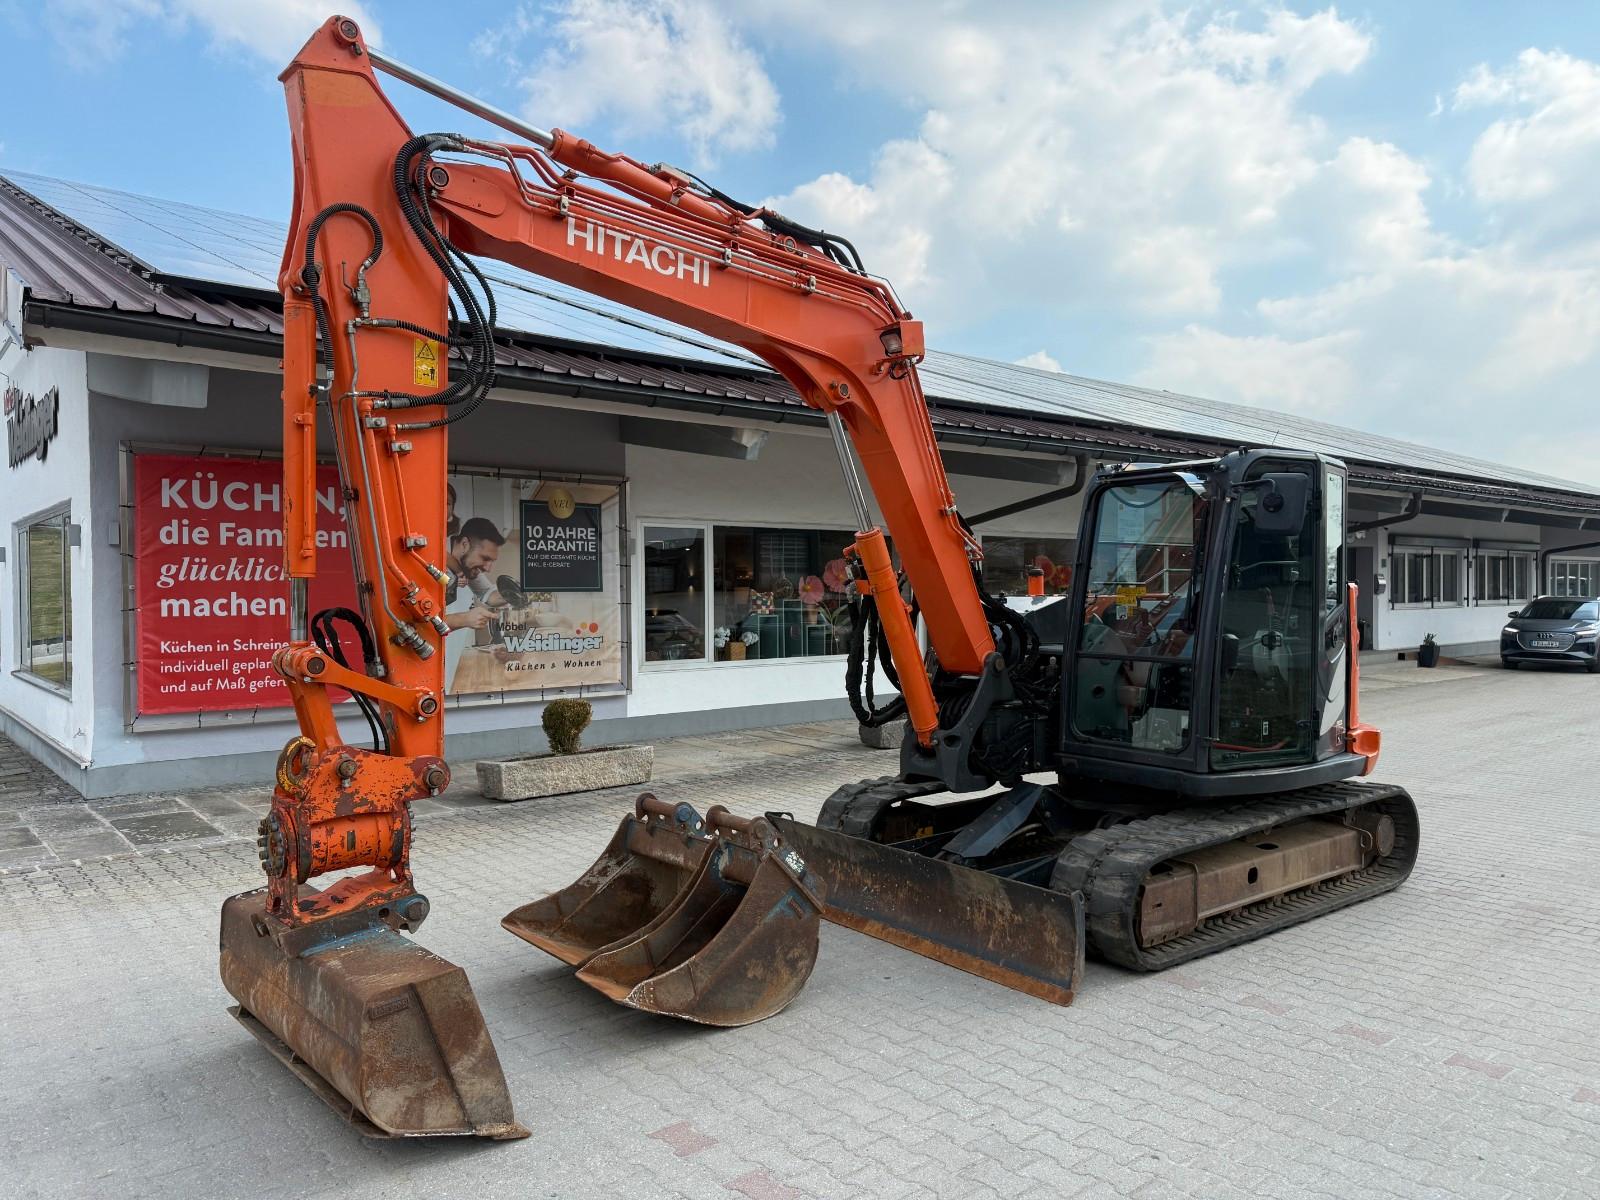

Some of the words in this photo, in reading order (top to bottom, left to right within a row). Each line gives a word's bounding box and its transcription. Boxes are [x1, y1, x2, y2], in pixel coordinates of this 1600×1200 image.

[567, 217, 710, 287] HITACHI
[161, 471, 347, 522] KÜCHN,
[159, 519, 210, 545] die
[219, 522, 347, 549] Famen
[526, 525, 543, 539] 10
[547, 526, 596, 540] JAHRE
[526, 540, 597, 552] GARANTIE
[160, 591, 287, 617] machen
[496, 622, 527, 632] Möbel
[160, 640, 213, 654] Küchen
[217, 640, 229, 652] in
[503, 627, 604, 654] Weidinger
[160, 658, 228, 673] individuell
[506, 661, 546, 672] Küchen
[563, 659, 602, 668] Wohnen
[160, 680, 186, 693] und
[190, 679, 213, 692] auf
[216, 677, 246, 691] Maß
